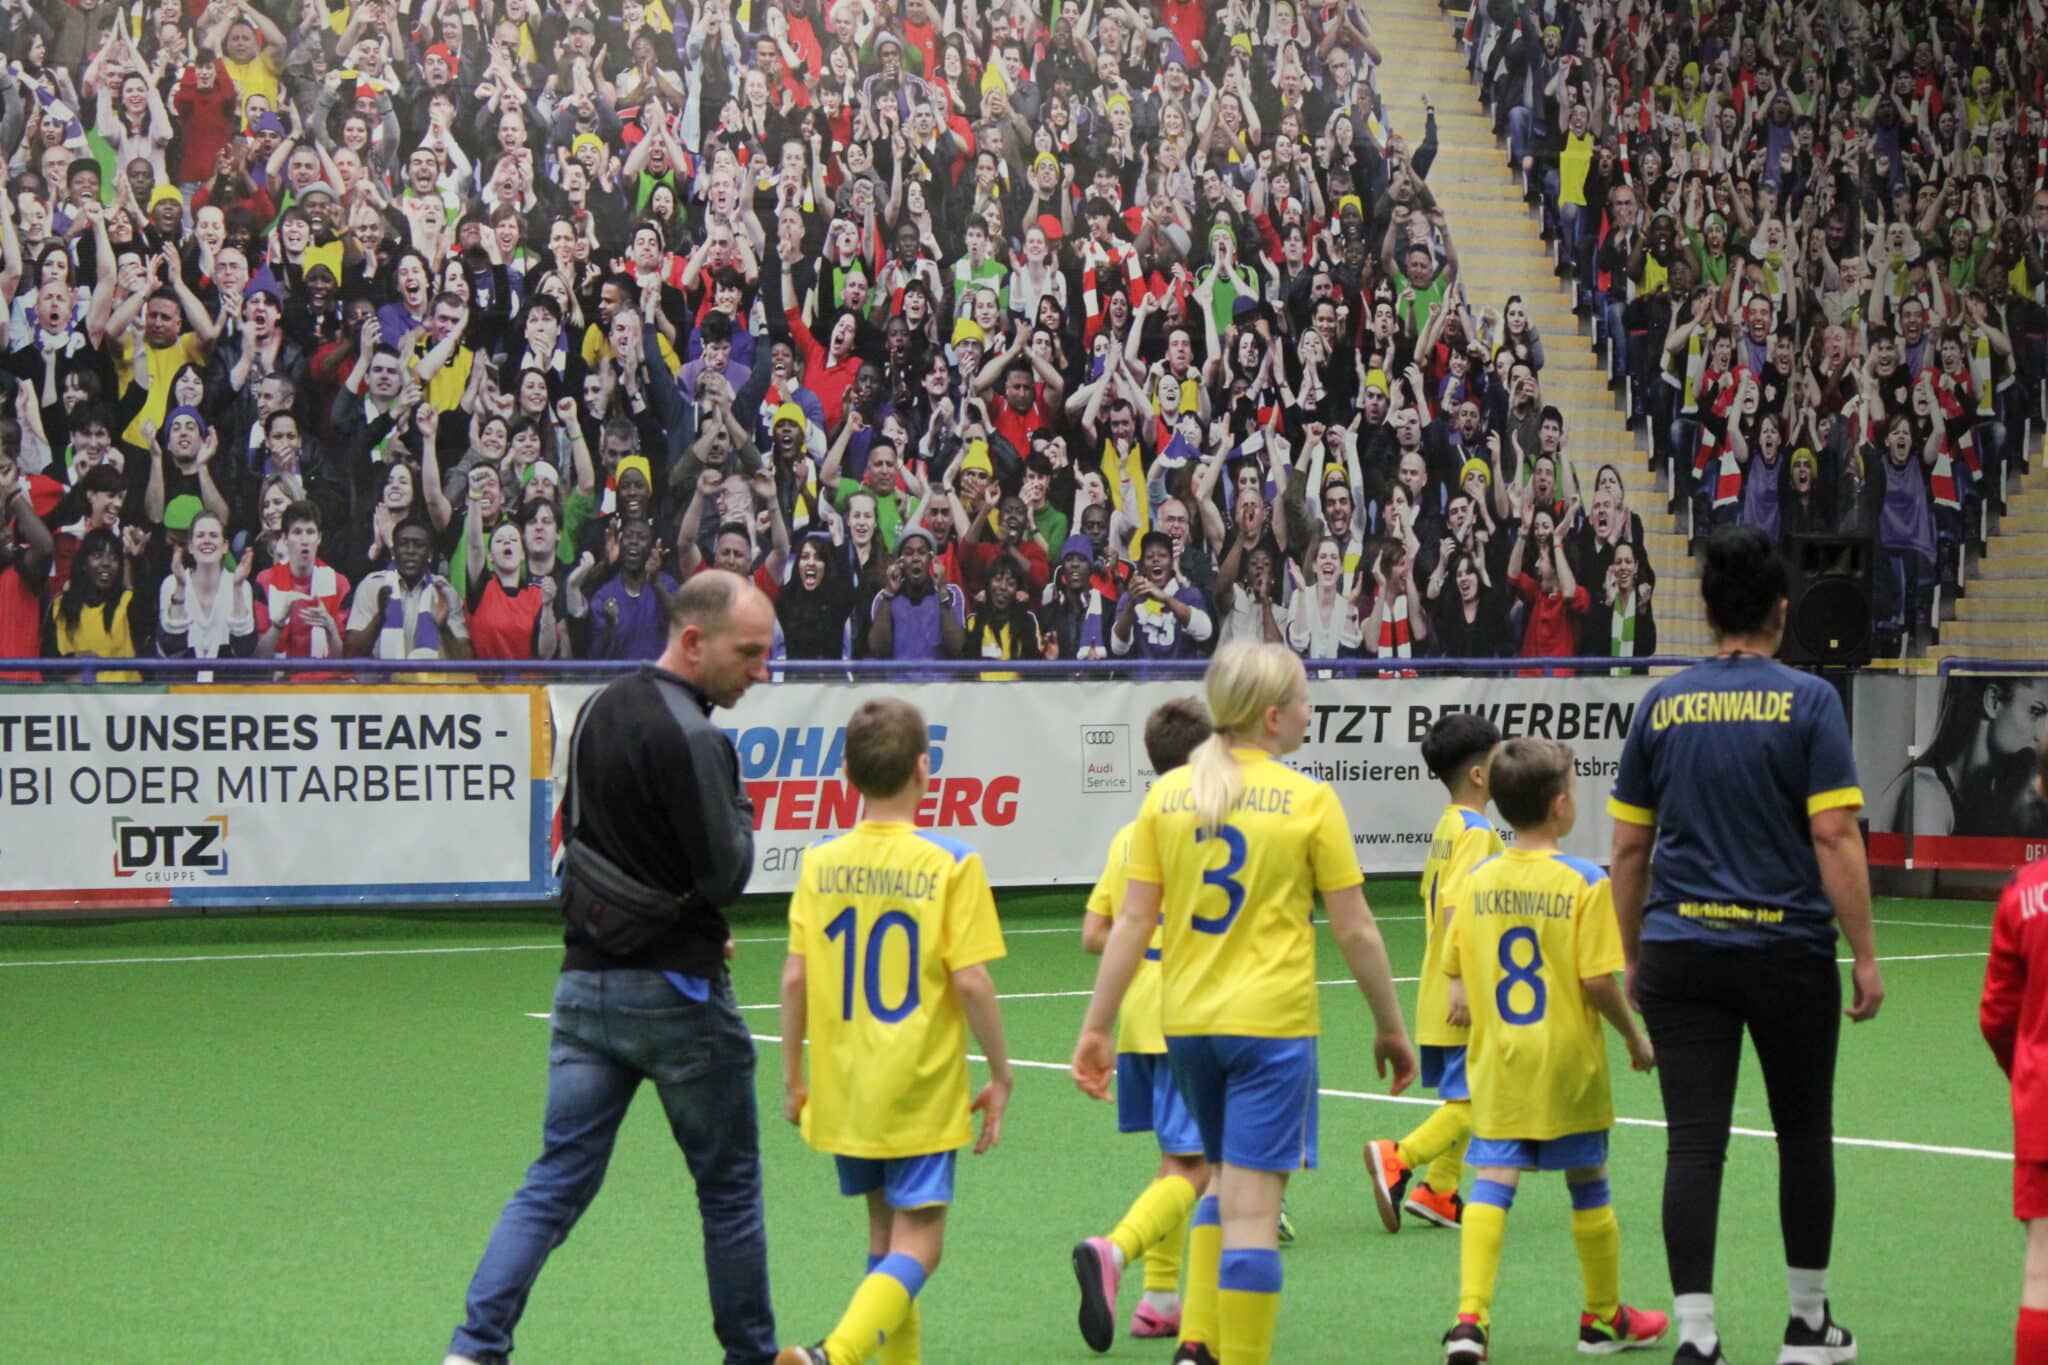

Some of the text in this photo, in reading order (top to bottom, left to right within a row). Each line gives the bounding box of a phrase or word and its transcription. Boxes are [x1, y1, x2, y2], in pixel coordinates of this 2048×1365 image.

[1652, 691, 1793, 731] LUCKENWALDE
[0, 715, 91, 752] TEIL
[106, 714, 318, 751] UNSERES
[331, 713, 482, 750] TEAMS
[0, 764, 516, 805] BI ODER MITARBEITER
[1087, 776, 1127, 788] Service
[1088, 763, 1113, 774] Audi
[120, 825, 219, 867] DTZ
[145, 872, 196, 882] GRUPPE
[818, 866, 940, 901] LUCKENWALDE
[1191, 824, 1248, 935] 3
[824, 906, 921, 1024] 10
[1495, 926, 1547, 1026] 8
